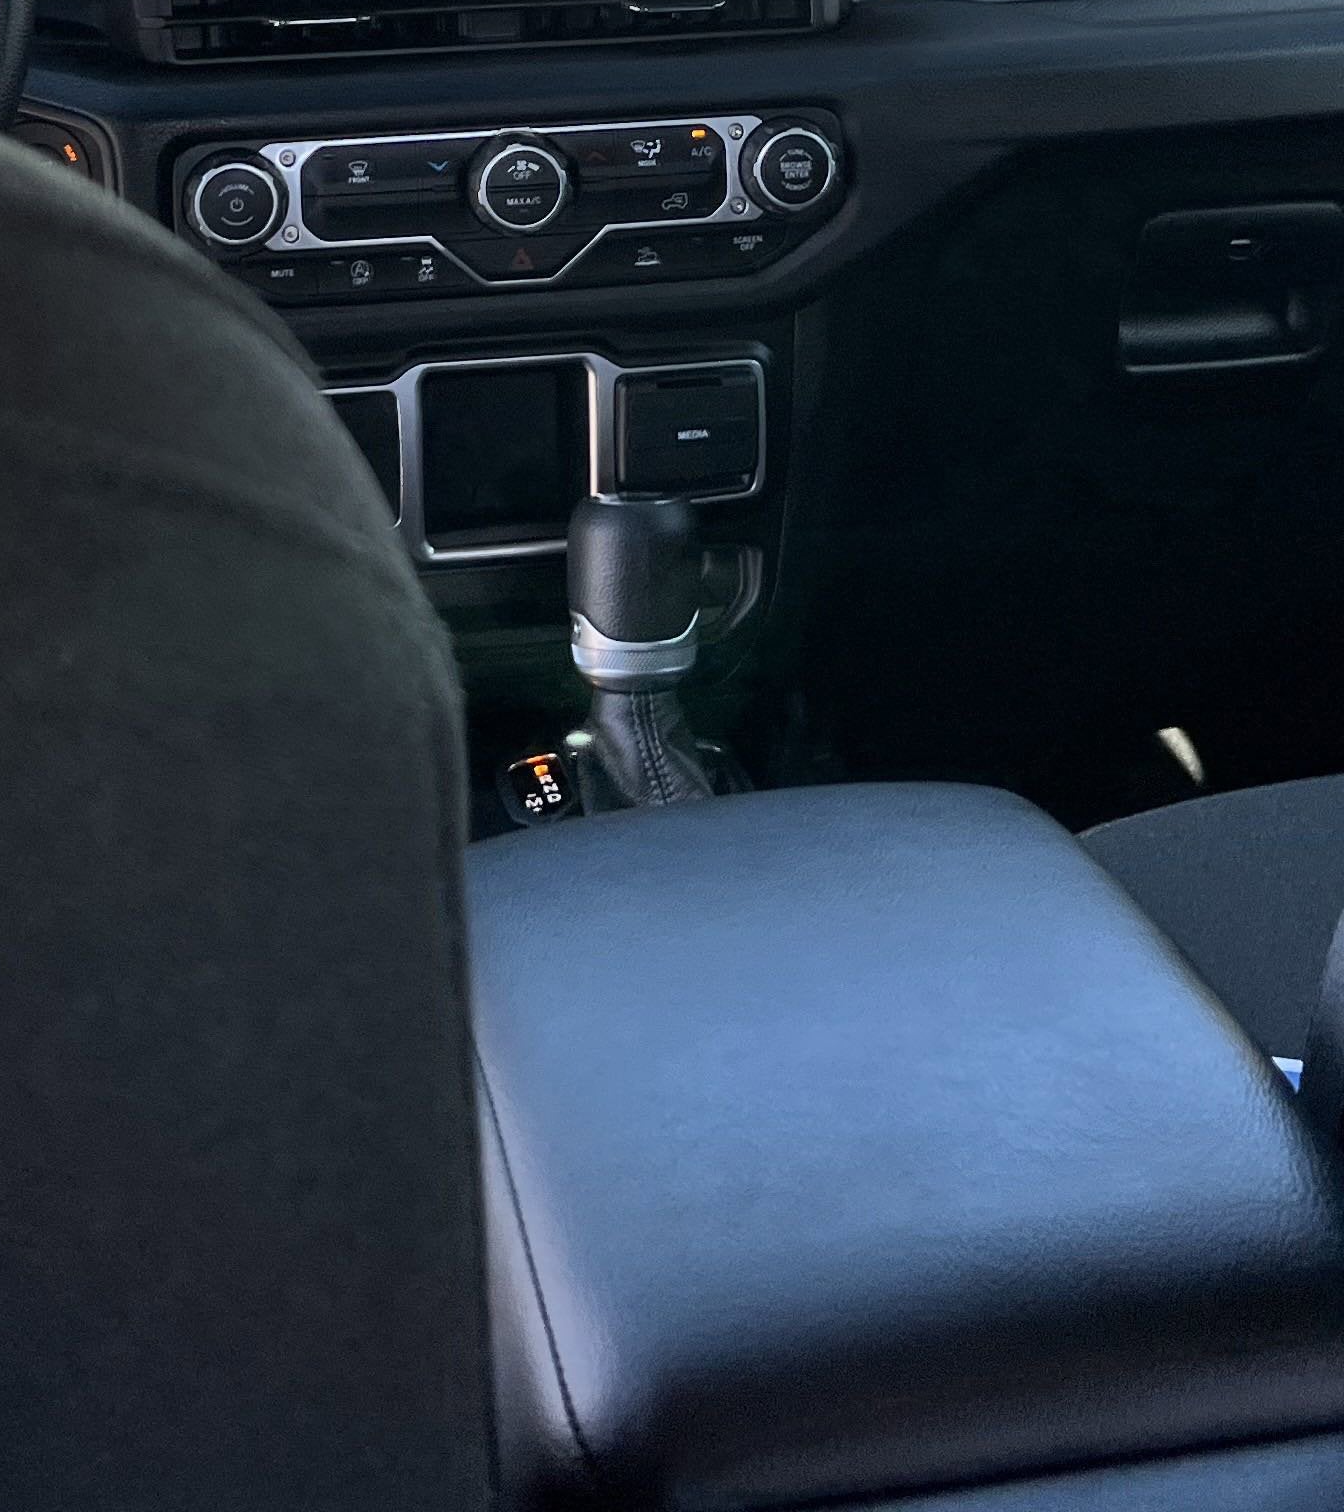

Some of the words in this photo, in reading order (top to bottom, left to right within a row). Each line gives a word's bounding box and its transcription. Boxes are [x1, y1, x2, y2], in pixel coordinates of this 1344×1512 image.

[690, 147, 712, 158] A/C
[513, 171, 531, 181] OFF
[506, 197, 525, 207] MAX
[526, 195, 542, 206] A/C
[733, 235, 764, 245] SCREEN
[739, 243, 755, 251] OFF
[271, 268, 295, 278] MUTE
[677, 429, 709, 441] MEDIA
[547, 793, 562, 804] D
